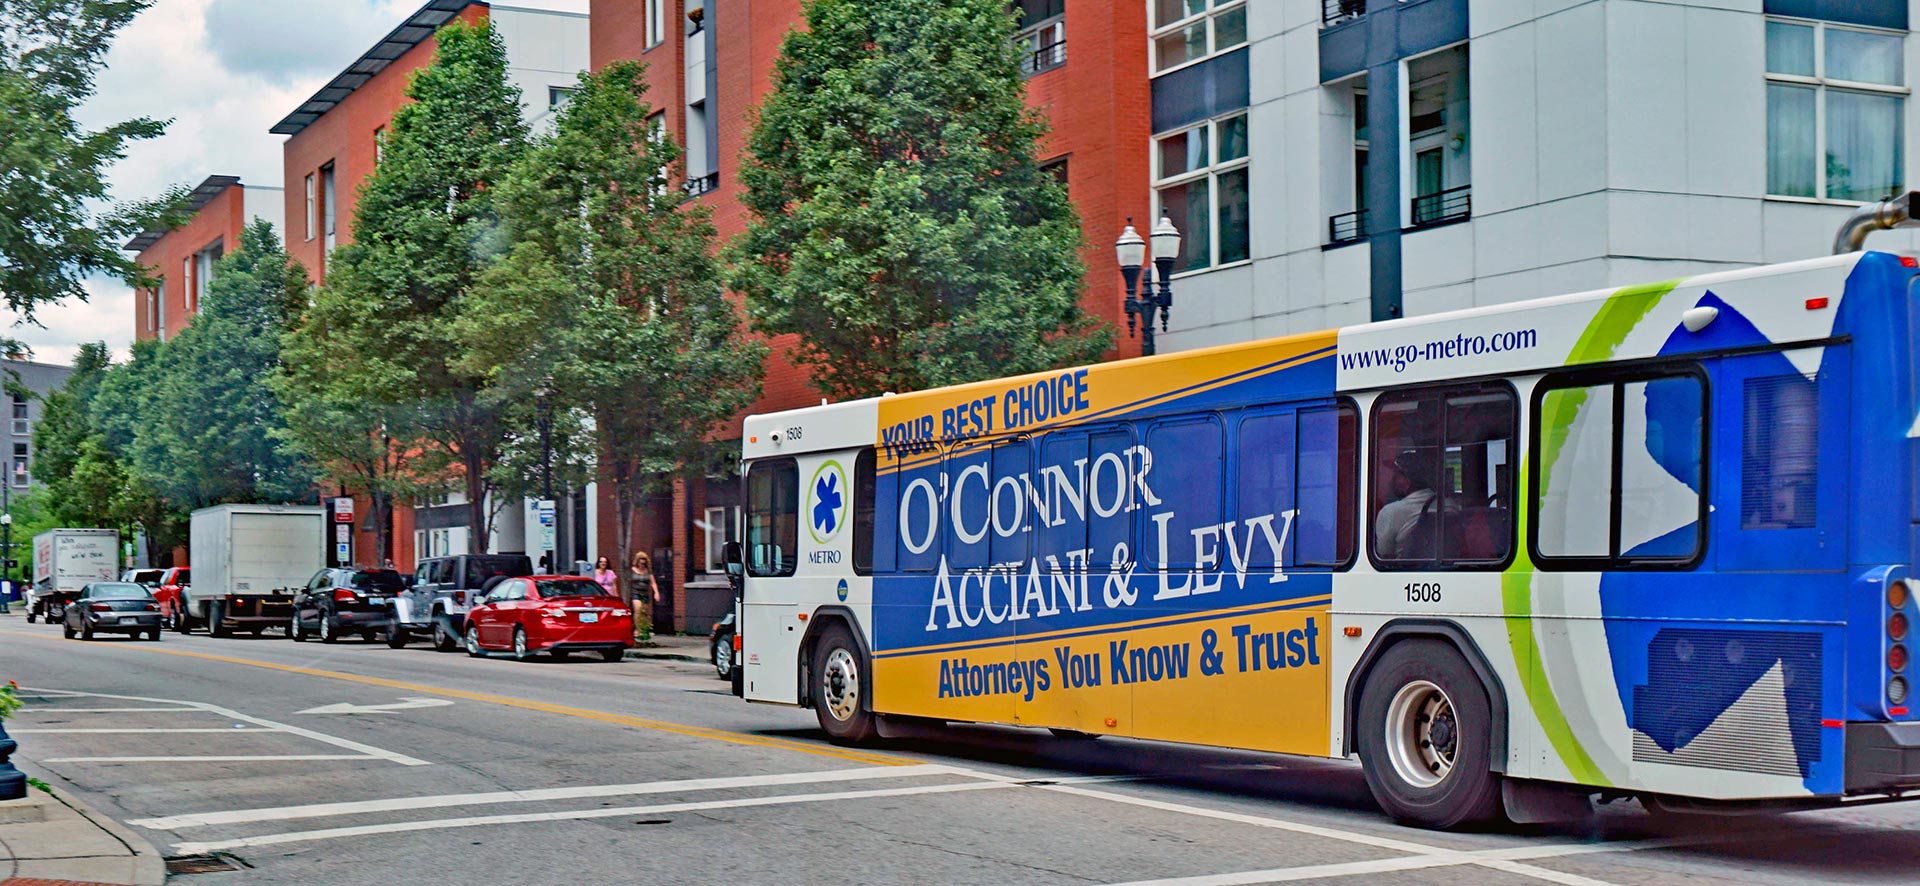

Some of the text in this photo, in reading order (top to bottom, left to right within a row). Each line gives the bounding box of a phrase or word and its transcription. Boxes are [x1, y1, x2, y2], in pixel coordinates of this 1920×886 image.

[1340, 326, 1537, 373] www.go-metro.com
[786, 426, 803, 441] 1508
[882, 368, 1090, 460] YOUR BEST CHOICE
[808, 550, 841, 565] METRO
[925, 508, 1300, 632] ACCIANI & LEVY
[1403, 582, 1442, 603] 1508
[938, 617, 1320, 702] Attorneys You Know & Trust
